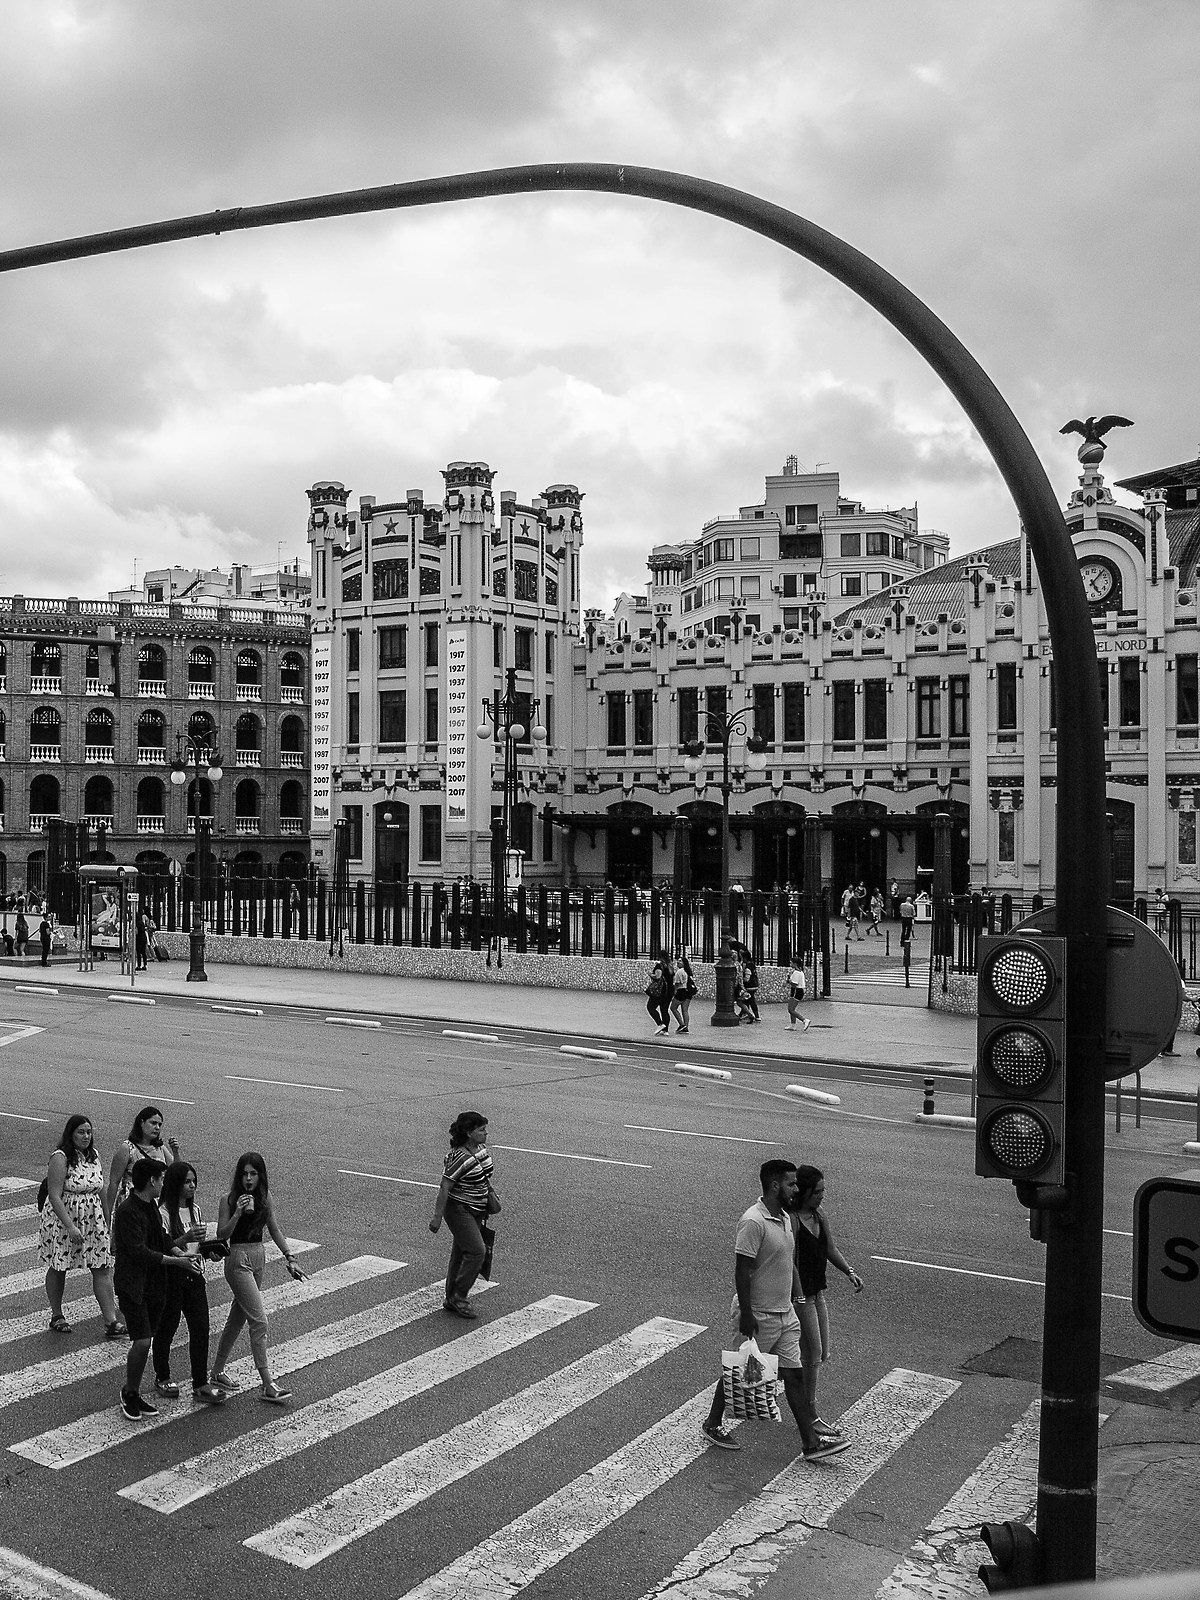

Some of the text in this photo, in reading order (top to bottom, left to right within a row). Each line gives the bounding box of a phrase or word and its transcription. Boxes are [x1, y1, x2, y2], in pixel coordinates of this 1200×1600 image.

[1096, 640, 1147, 653] EL NORD
[449, 651, 465, 659] 1917
[449, 692, 465, 700] 1947
[449, 733, 465, 741] 1977
[449, 747, 465, 755] 1987
[1160, 1236, 1200, 1283] S
